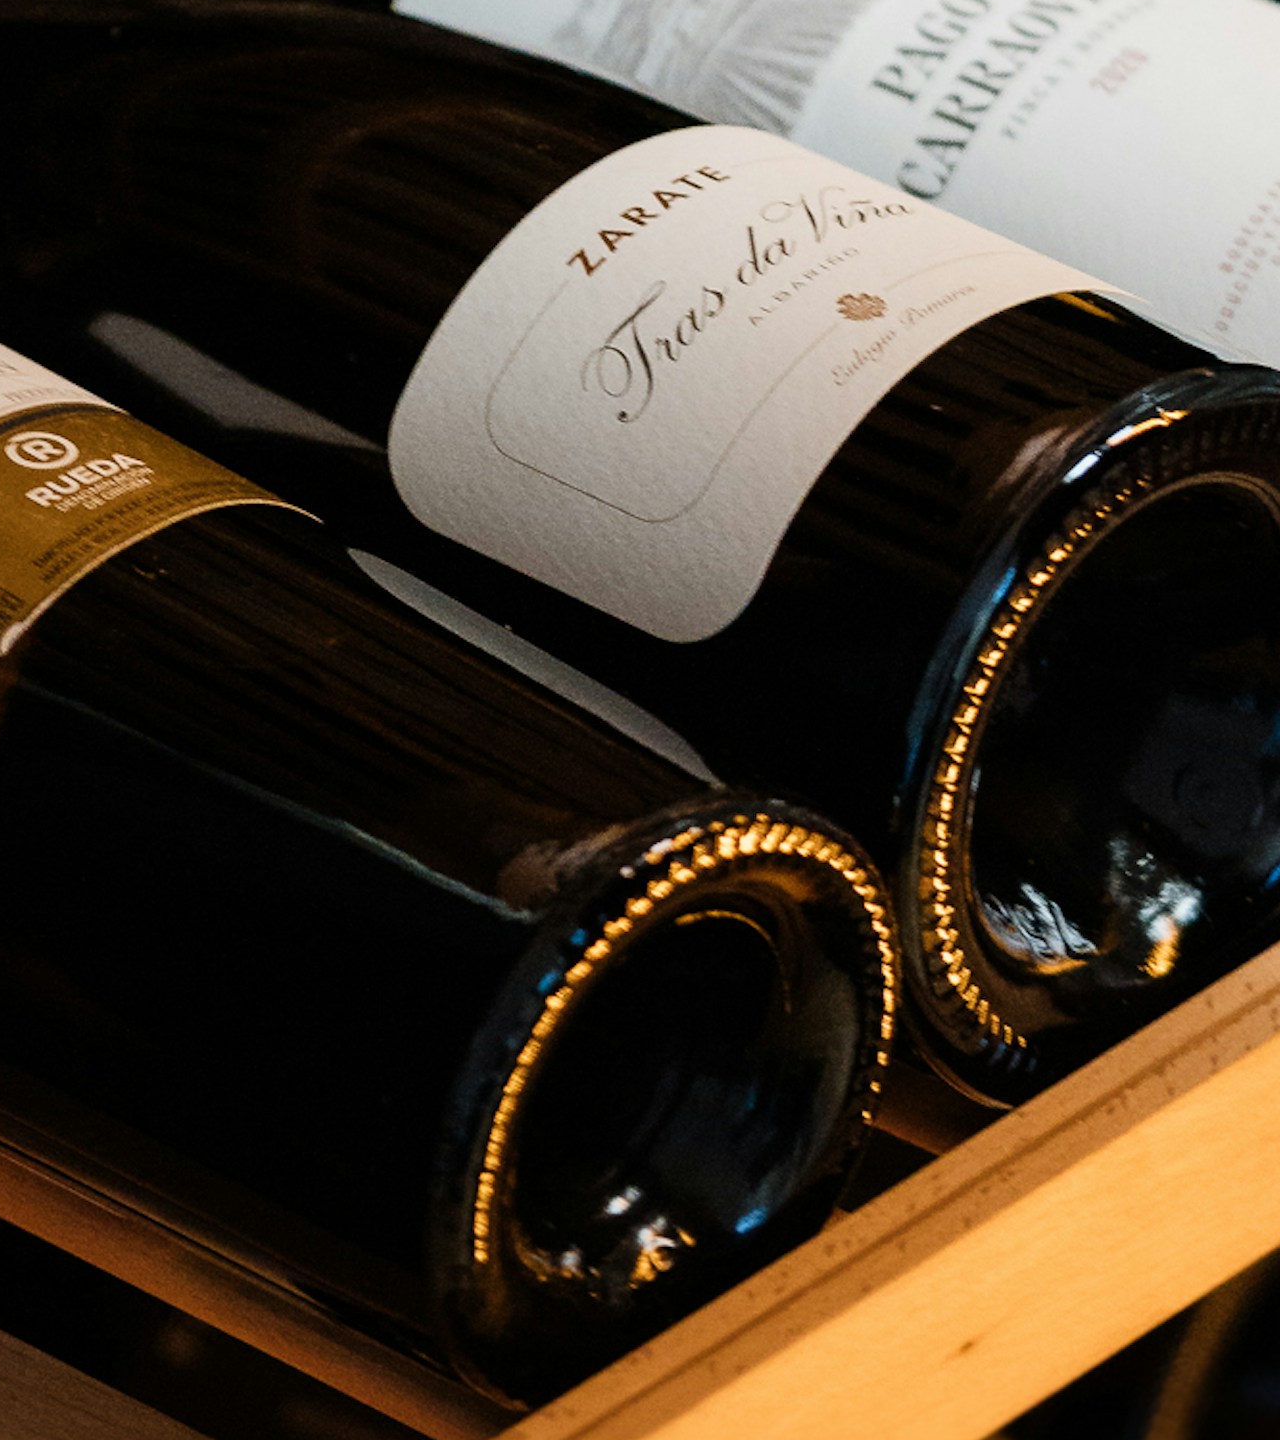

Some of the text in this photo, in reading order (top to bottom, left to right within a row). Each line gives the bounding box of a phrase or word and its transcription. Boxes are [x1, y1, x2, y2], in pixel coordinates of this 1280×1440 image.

[566, 164, 732, 278] ZARATE
[580, 184, 915, 424] Tras da Viña
[747, 246, 862, 328] ALBARIÑO
[24, 450, 148, 509] RUEDA
